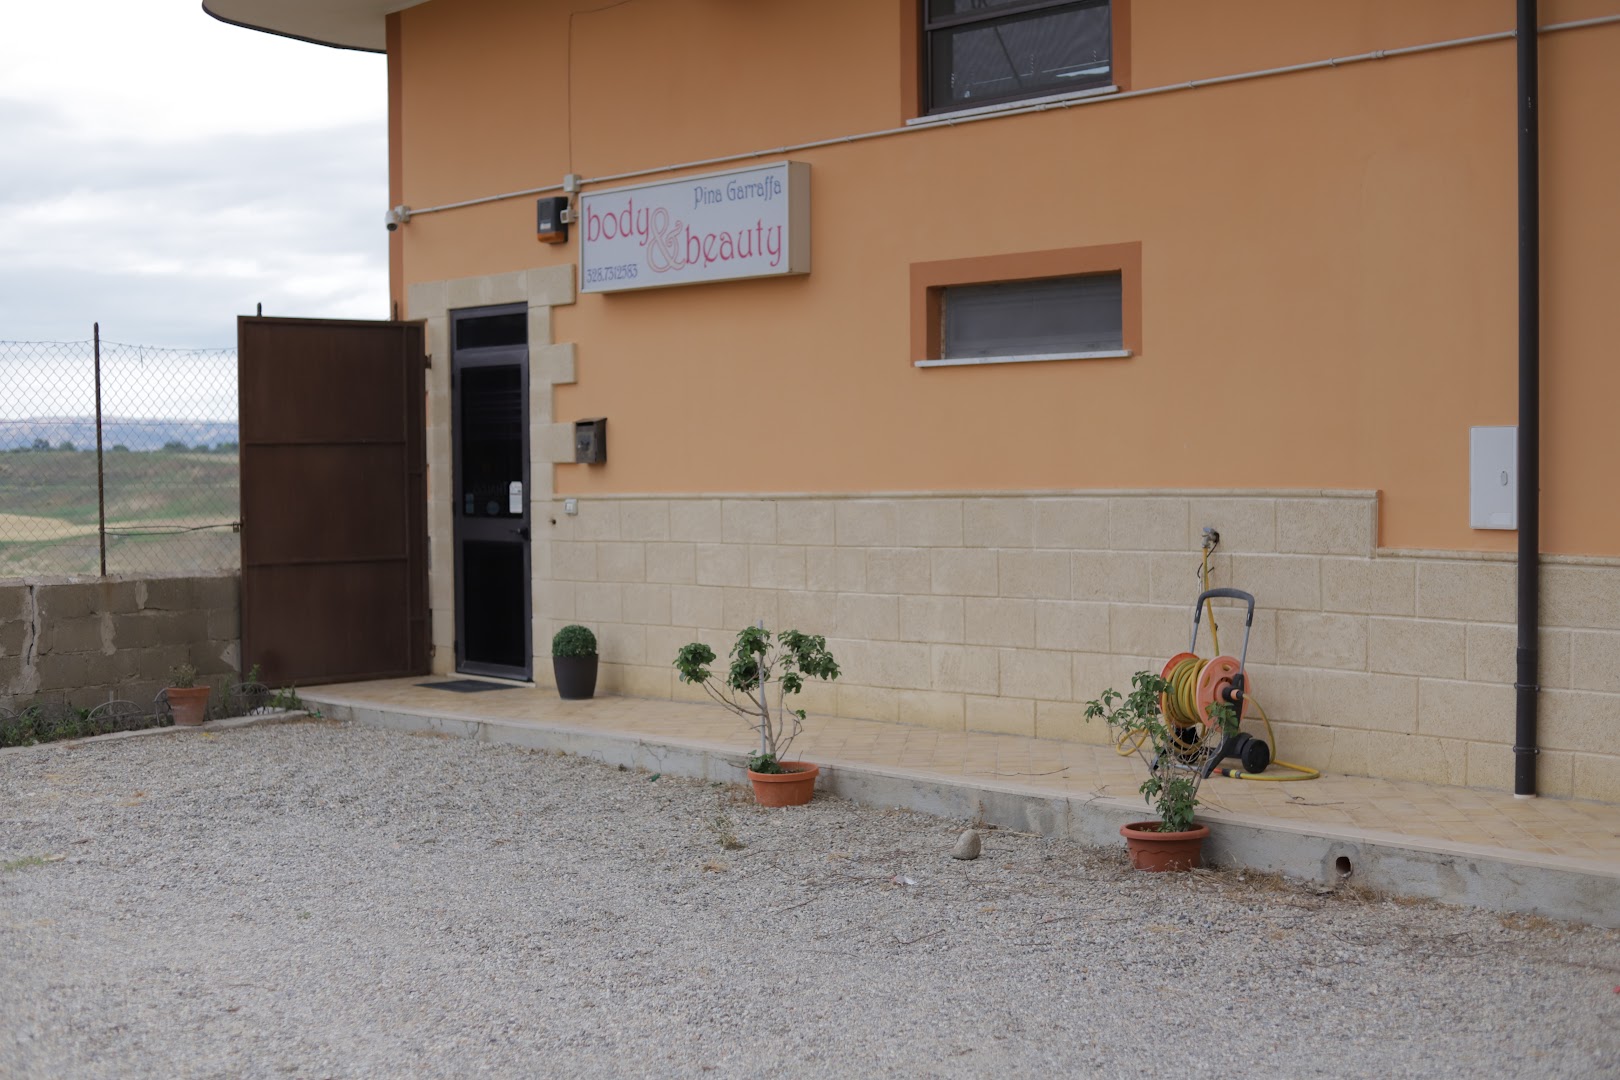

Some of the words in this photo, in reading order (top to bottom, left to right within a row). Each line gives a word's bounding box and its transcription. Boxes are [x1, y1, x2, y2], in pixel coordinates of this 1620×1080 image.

[726, 175, 782, 202] Garraffa
[586, 198, 650, 246] body
[647, 207, 686, 273] &
[685, 218, 782, 267] beauty
